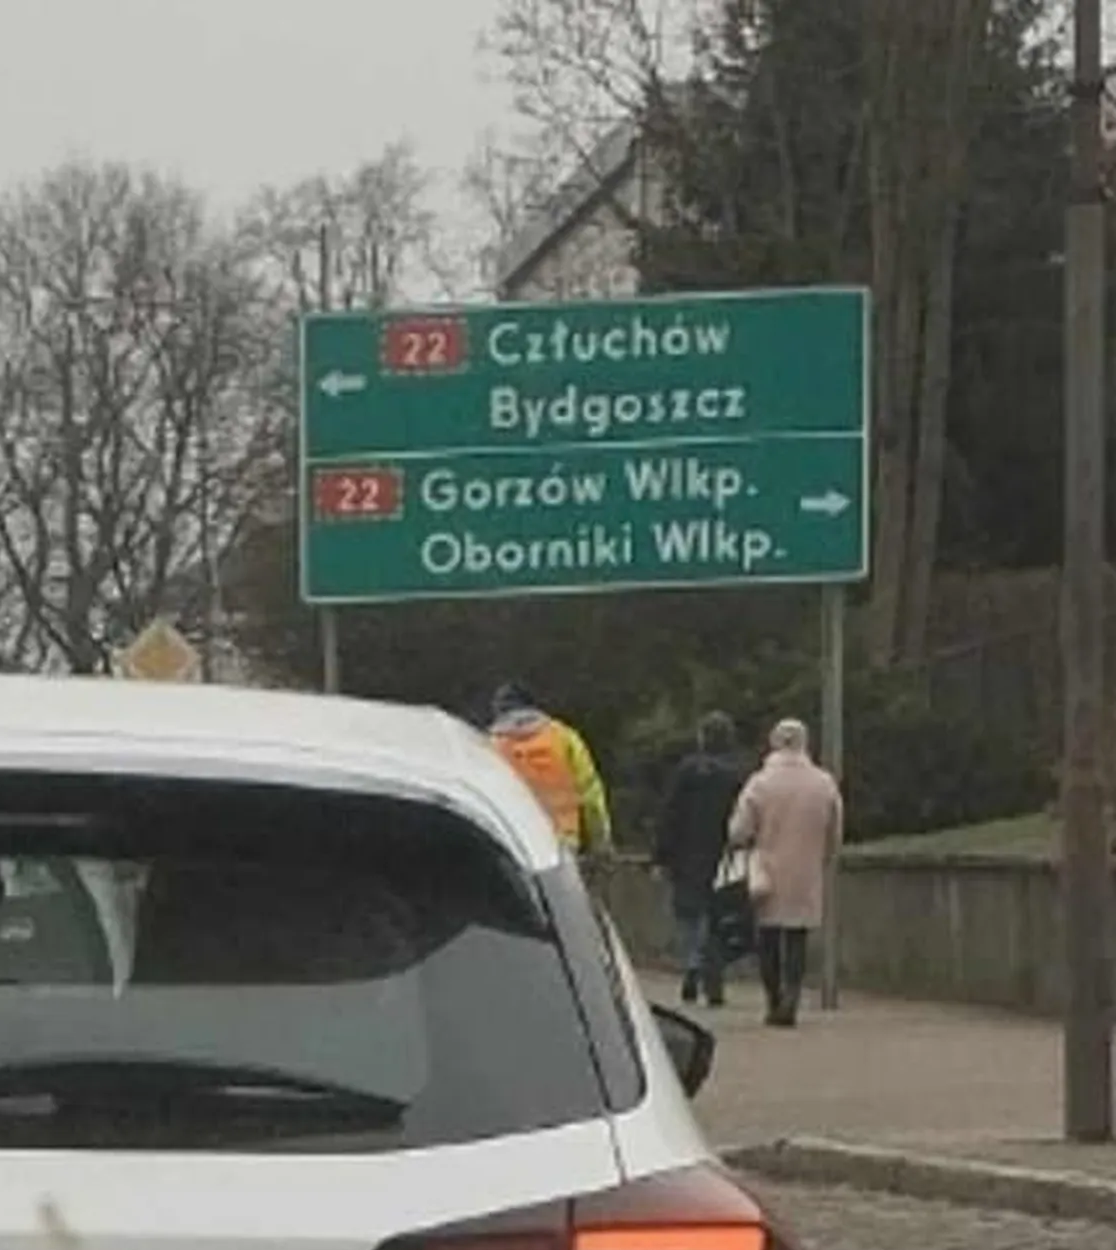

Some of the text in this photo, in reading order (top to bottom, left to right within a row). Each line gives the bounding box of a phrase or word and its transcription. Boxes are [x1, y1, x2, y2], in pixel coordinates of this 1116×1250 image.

[402, 333, 447, 366] 22
[489, 313, 731, 364] Człuchów
[490, 385, 746, 437] Bydgoszcz
[335, 480, 380, 512] 22
[421, 458, 759, 511] Gorzów Wlkp.
[422, 521, 788, 574] Oborniki Wlkp.
